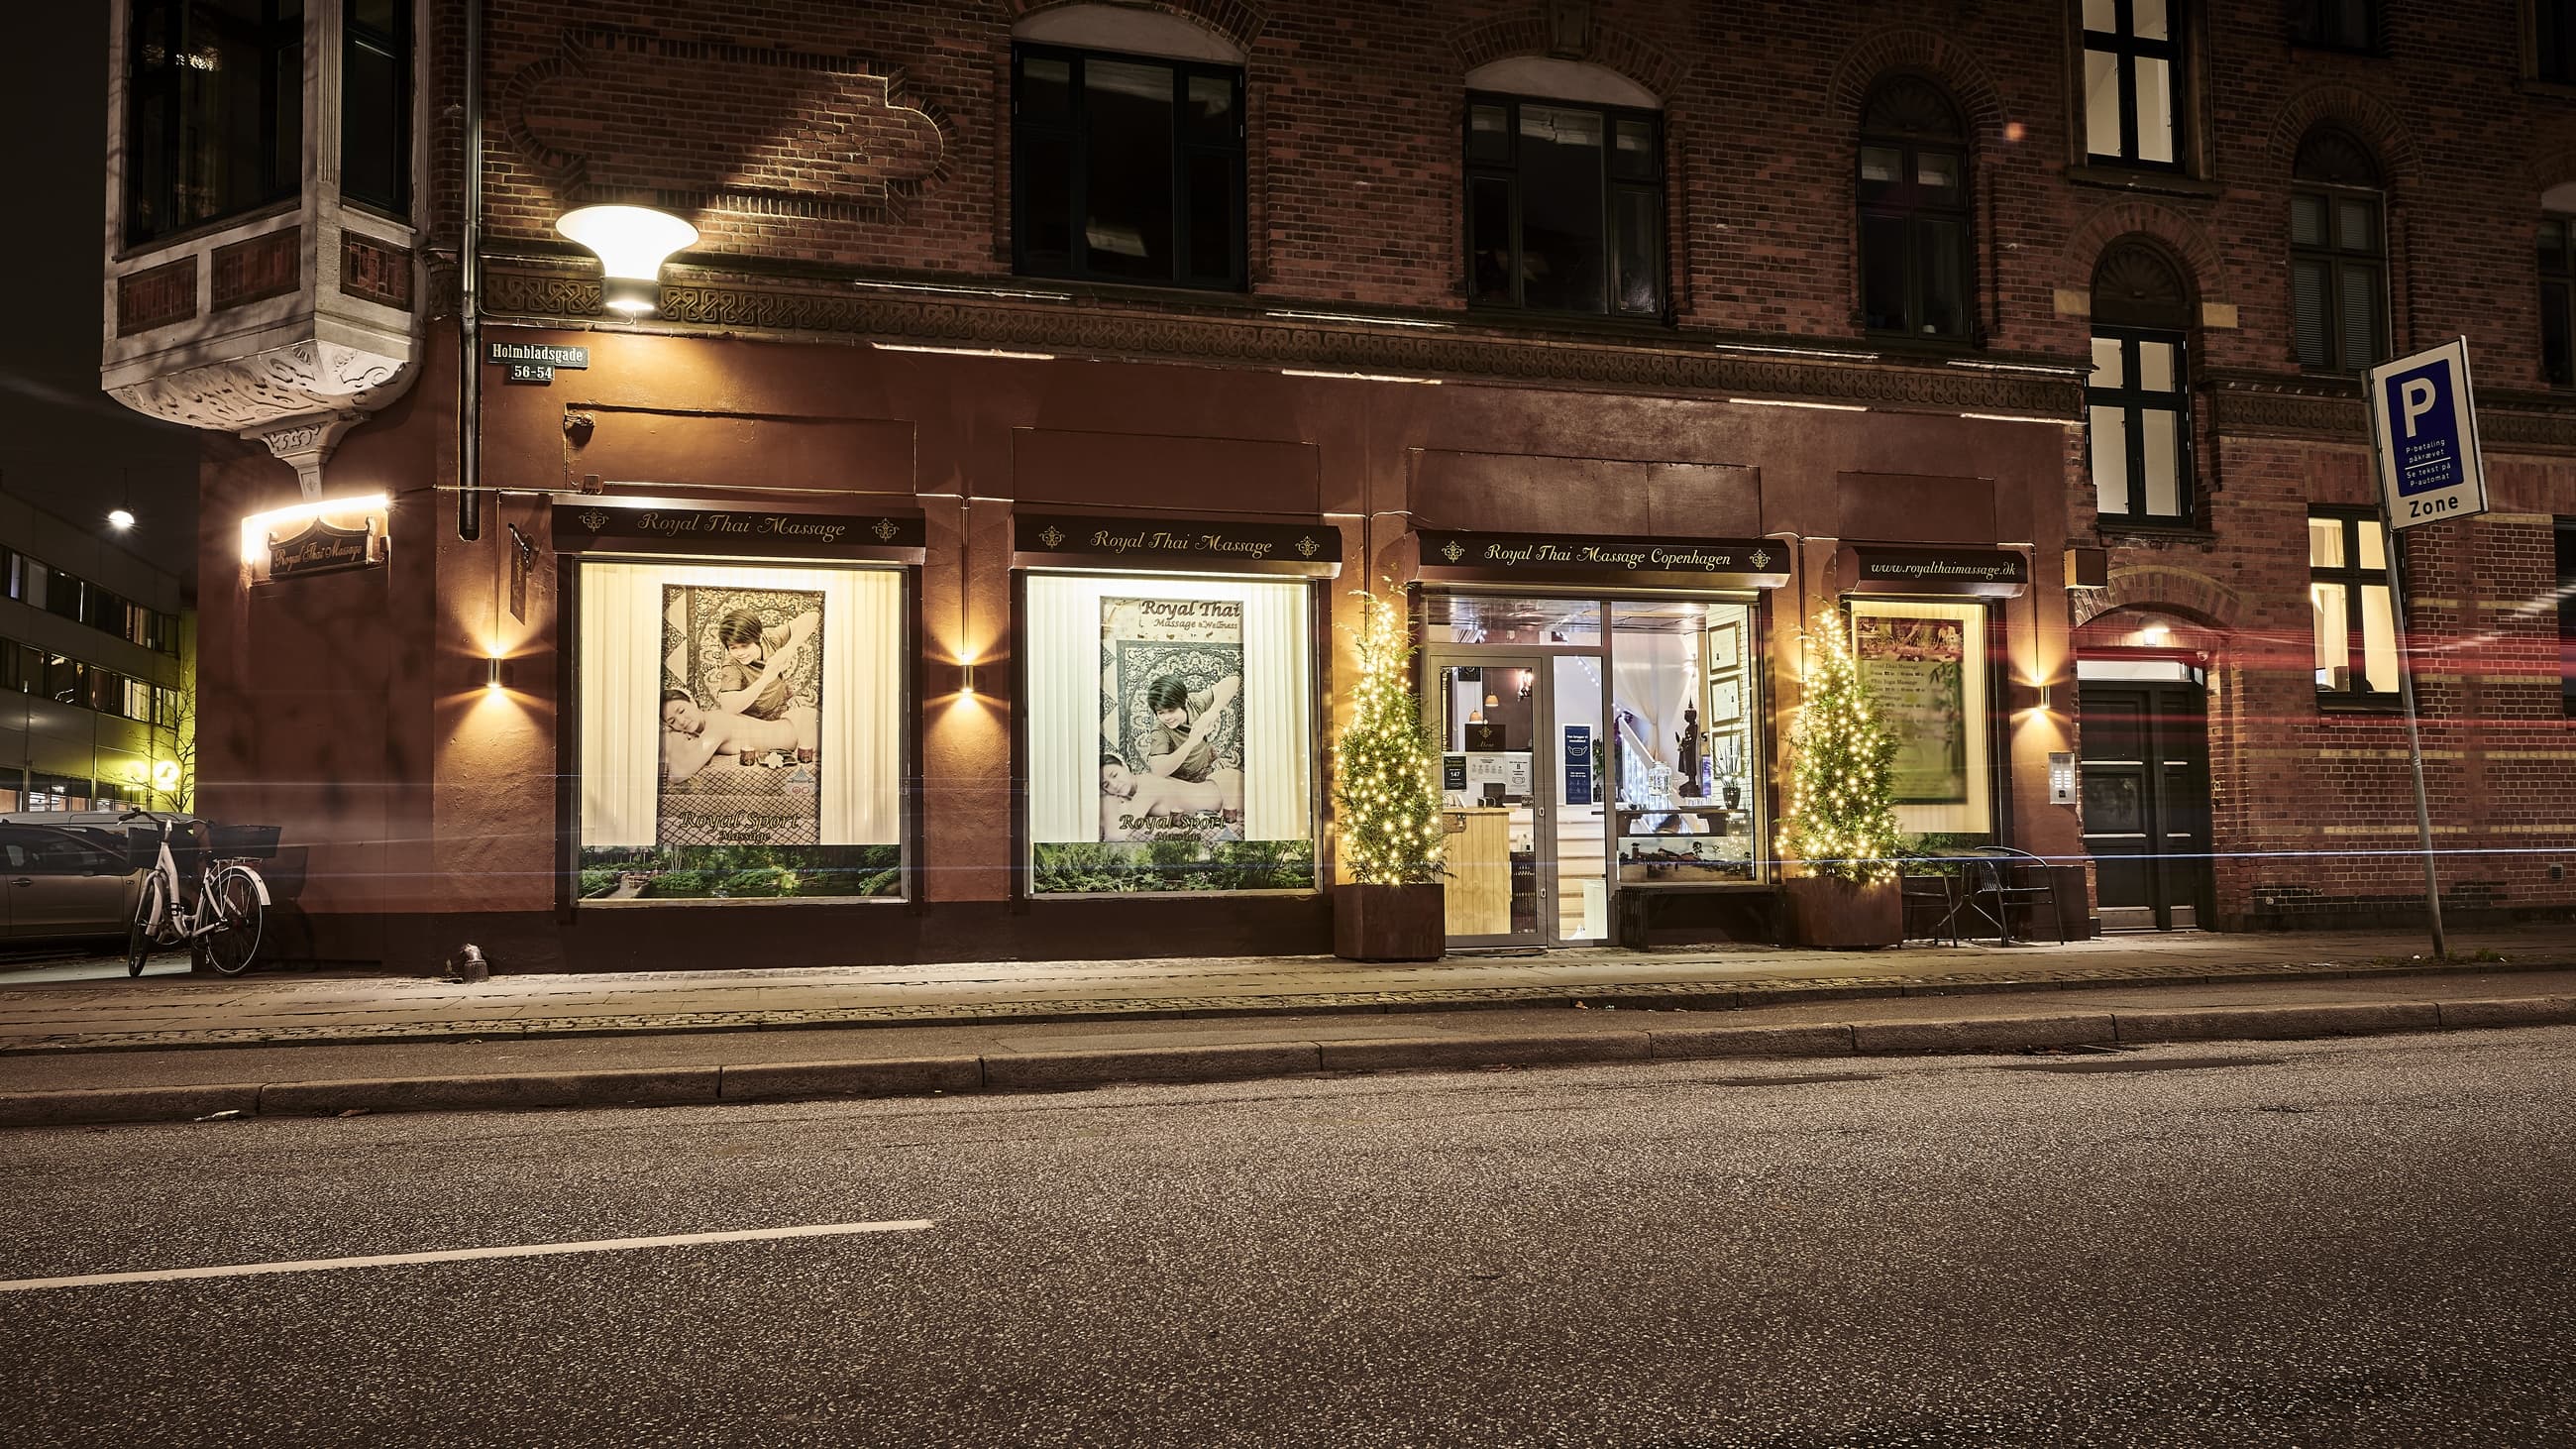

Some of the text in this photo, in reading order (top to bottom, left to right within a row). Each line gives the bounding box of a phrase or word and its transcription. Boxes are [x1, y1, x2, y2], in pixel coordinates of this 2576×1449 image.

[492, 343, 584, 363] Holmbladsgade
[514, 365, 553, 379] 56-54
[2401, 377, 2436, 438] P
[2406, 438, 2446, 454] P-betaling
[2409, 448, 2444, 464] påkrævet
[2406, 462, 2451, 479] Se tekst på
[2410, 472, 2450, 487] P-automat
[2409, 495, 2459, 518] Zone
[637, 511, 846, 542] Royal Thai Massage
[1090, 529, 1273, 559] Royal Thai Massage
[274, 545, 303, 572] Royal
[324, 538, 364, 562] Massage
[1484, 542, 1732, 571] Royal Thai Massage Copenhagen
[1871, 560, 2016, 580] www.royalthaimassage.dk
[1141, 600, 1241, 620] Royal Thai
[1153, 617, 1197, 630] Massage
[680, 810, 801, 834] Royal Sport
[1119, 814, 1227, 835] Royal Sport
[718, 830, 771, 842] Massage
